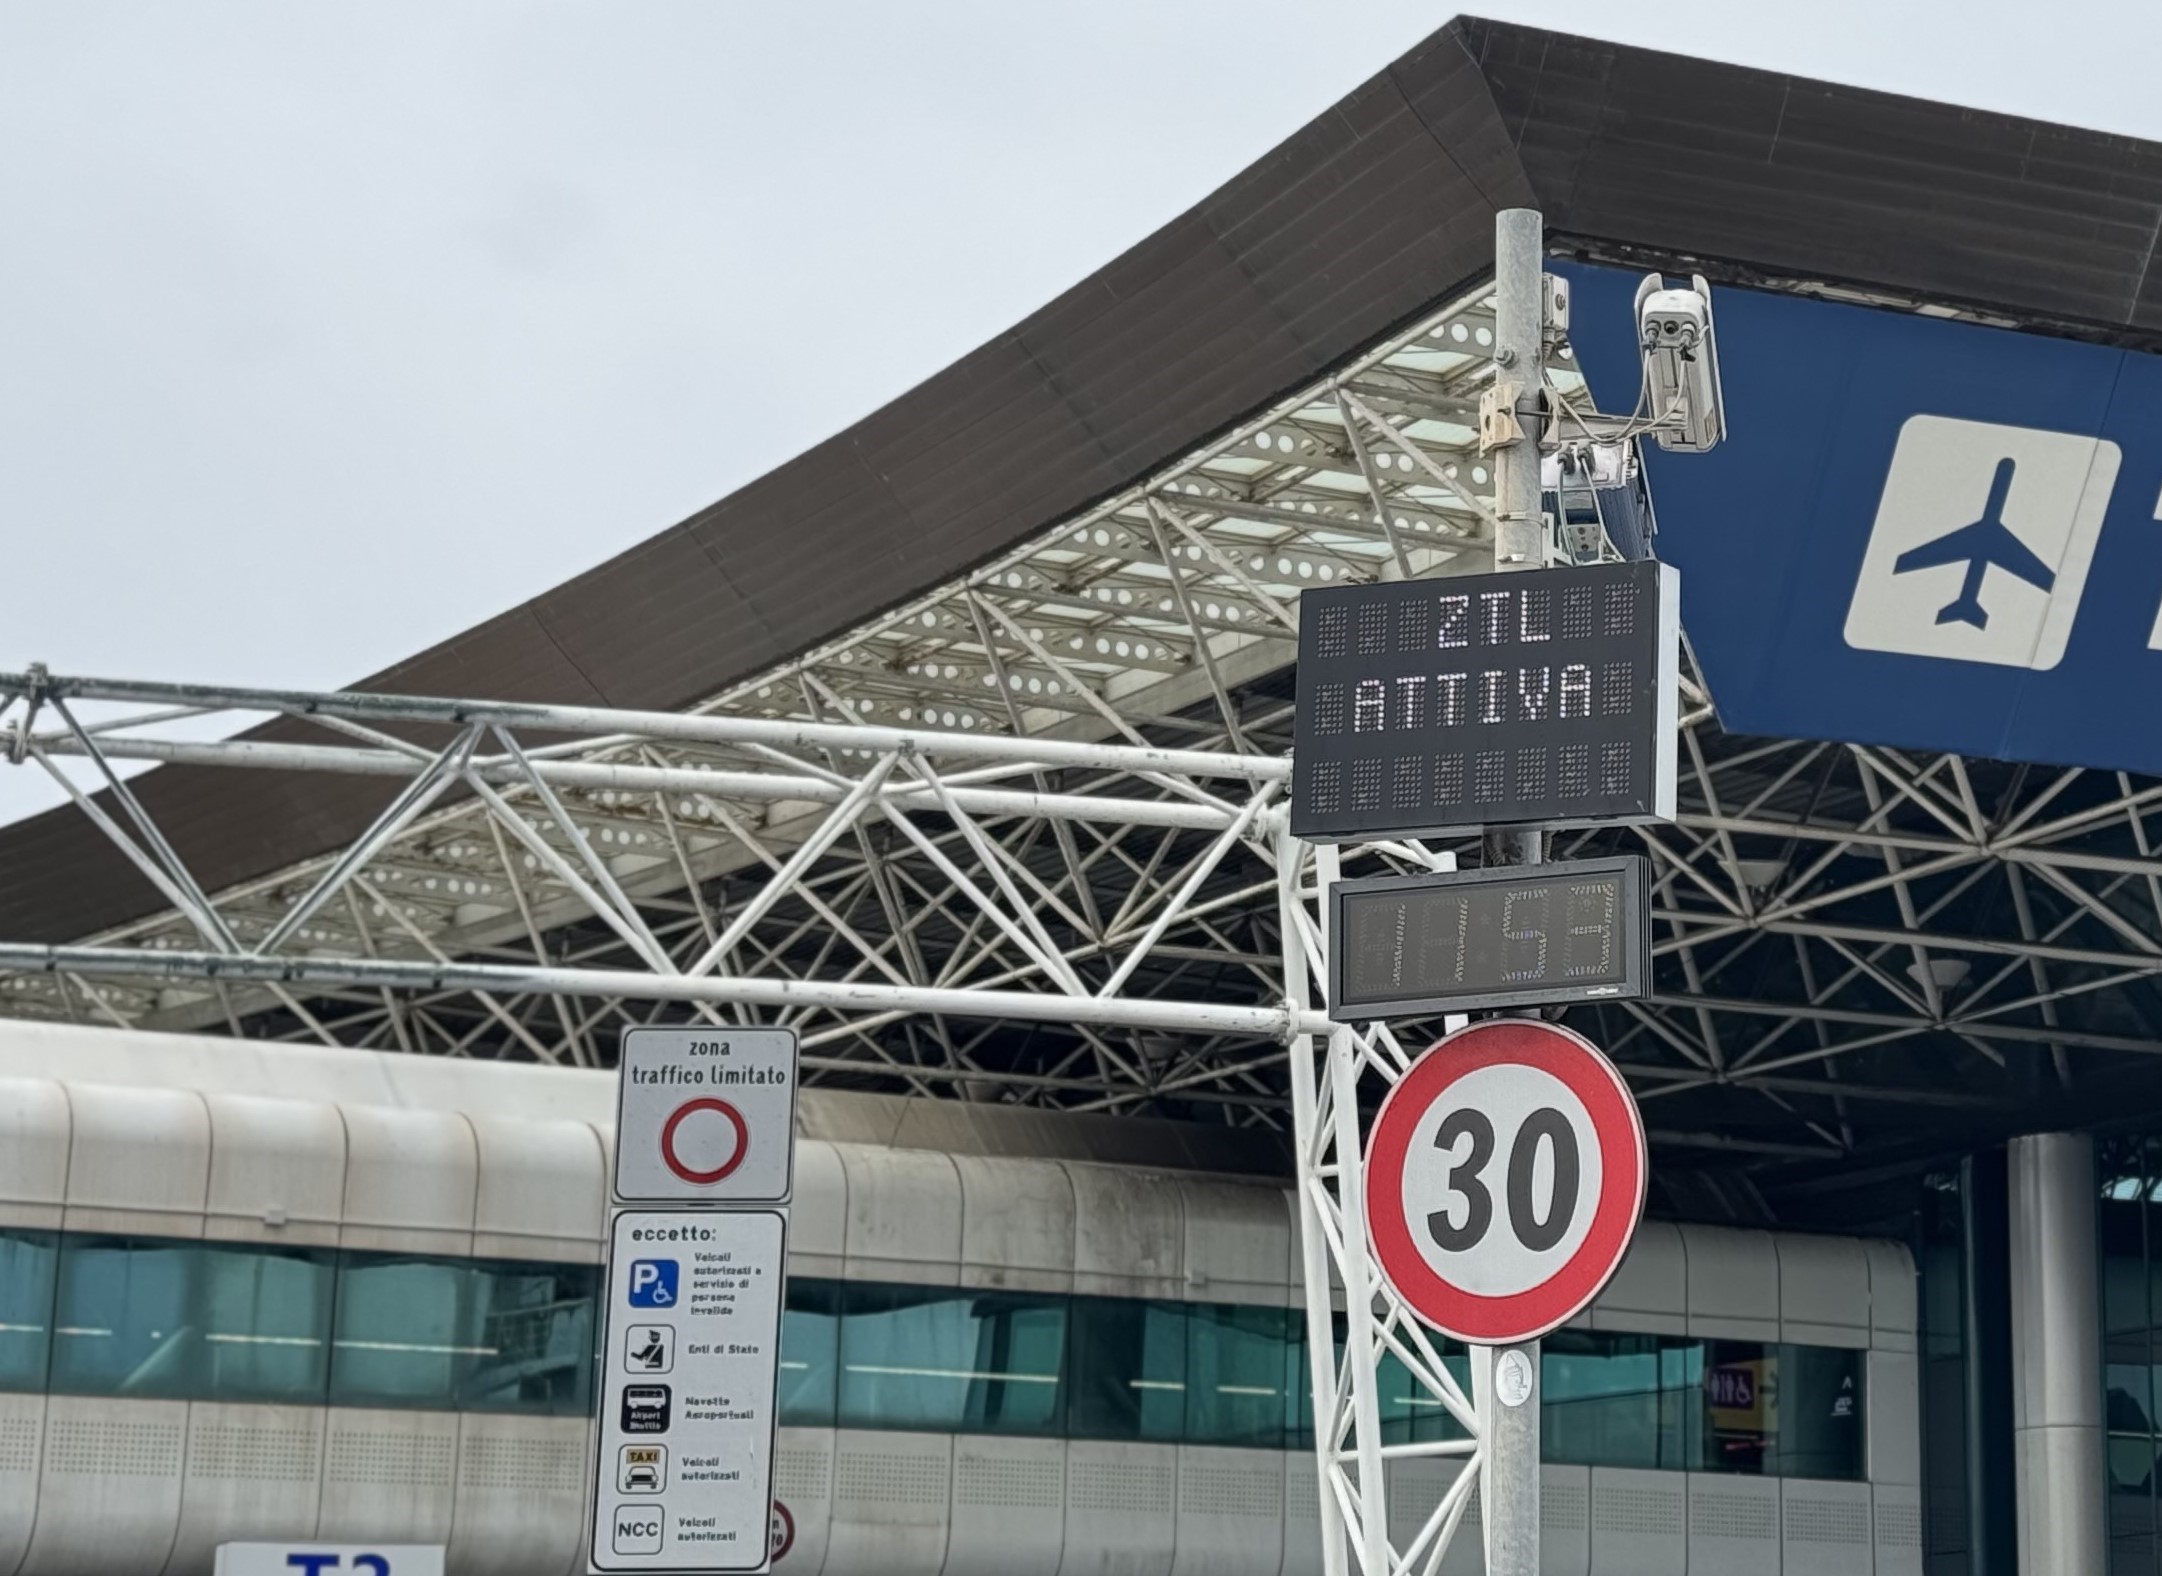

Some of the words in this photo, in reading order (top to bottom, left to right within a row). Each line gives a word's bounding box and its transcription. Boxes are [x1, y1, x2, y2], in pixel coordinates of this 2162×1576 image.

[1439, 590, 1550, 648] ZTL
[1354, 664, 1591, 732] ATTIVA
[689, 1041, 731, 1056] zona
[632, 1065, 703, 1084] traffico
[711, 1065, 785, 1084] limitato
[1427, 1107, 1580, 1252] 30
[632, 1225, 717, 1242] eccetto:
[688, 1344, 710, 1354] Enti
[713, 1344, 724, 1354] di
[728, 1344, 759, 1354] Stato
[630, 1452, 657, 1461] TAXI
[618, 1522, 659, 1537] NCC
